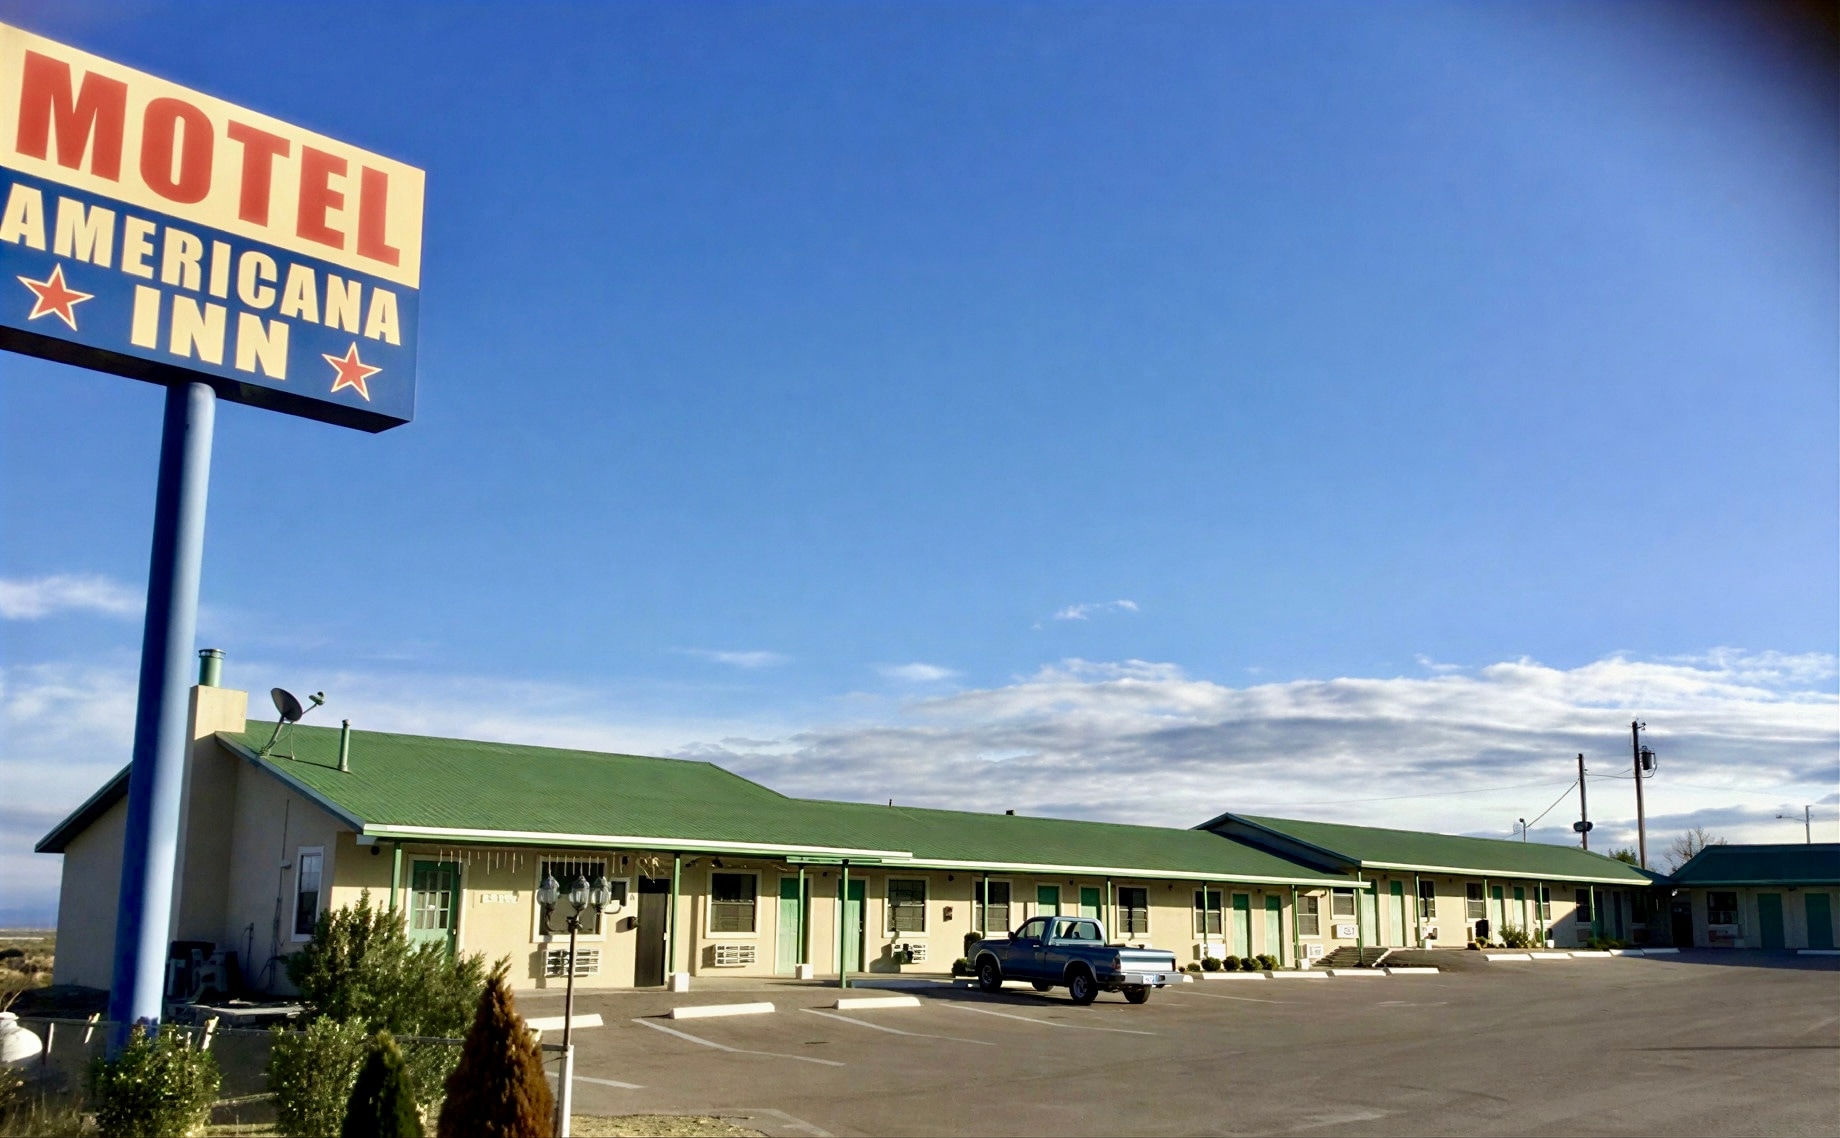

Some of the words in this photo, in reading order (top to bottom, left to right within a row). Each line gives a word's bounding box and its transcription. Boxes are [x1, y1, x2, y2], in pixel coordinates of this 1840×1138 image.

[16, 49, 400, 267] MOTEL
[0, 183, 401, 346] AMERICANA
[131, 285, 289, 380] INN
